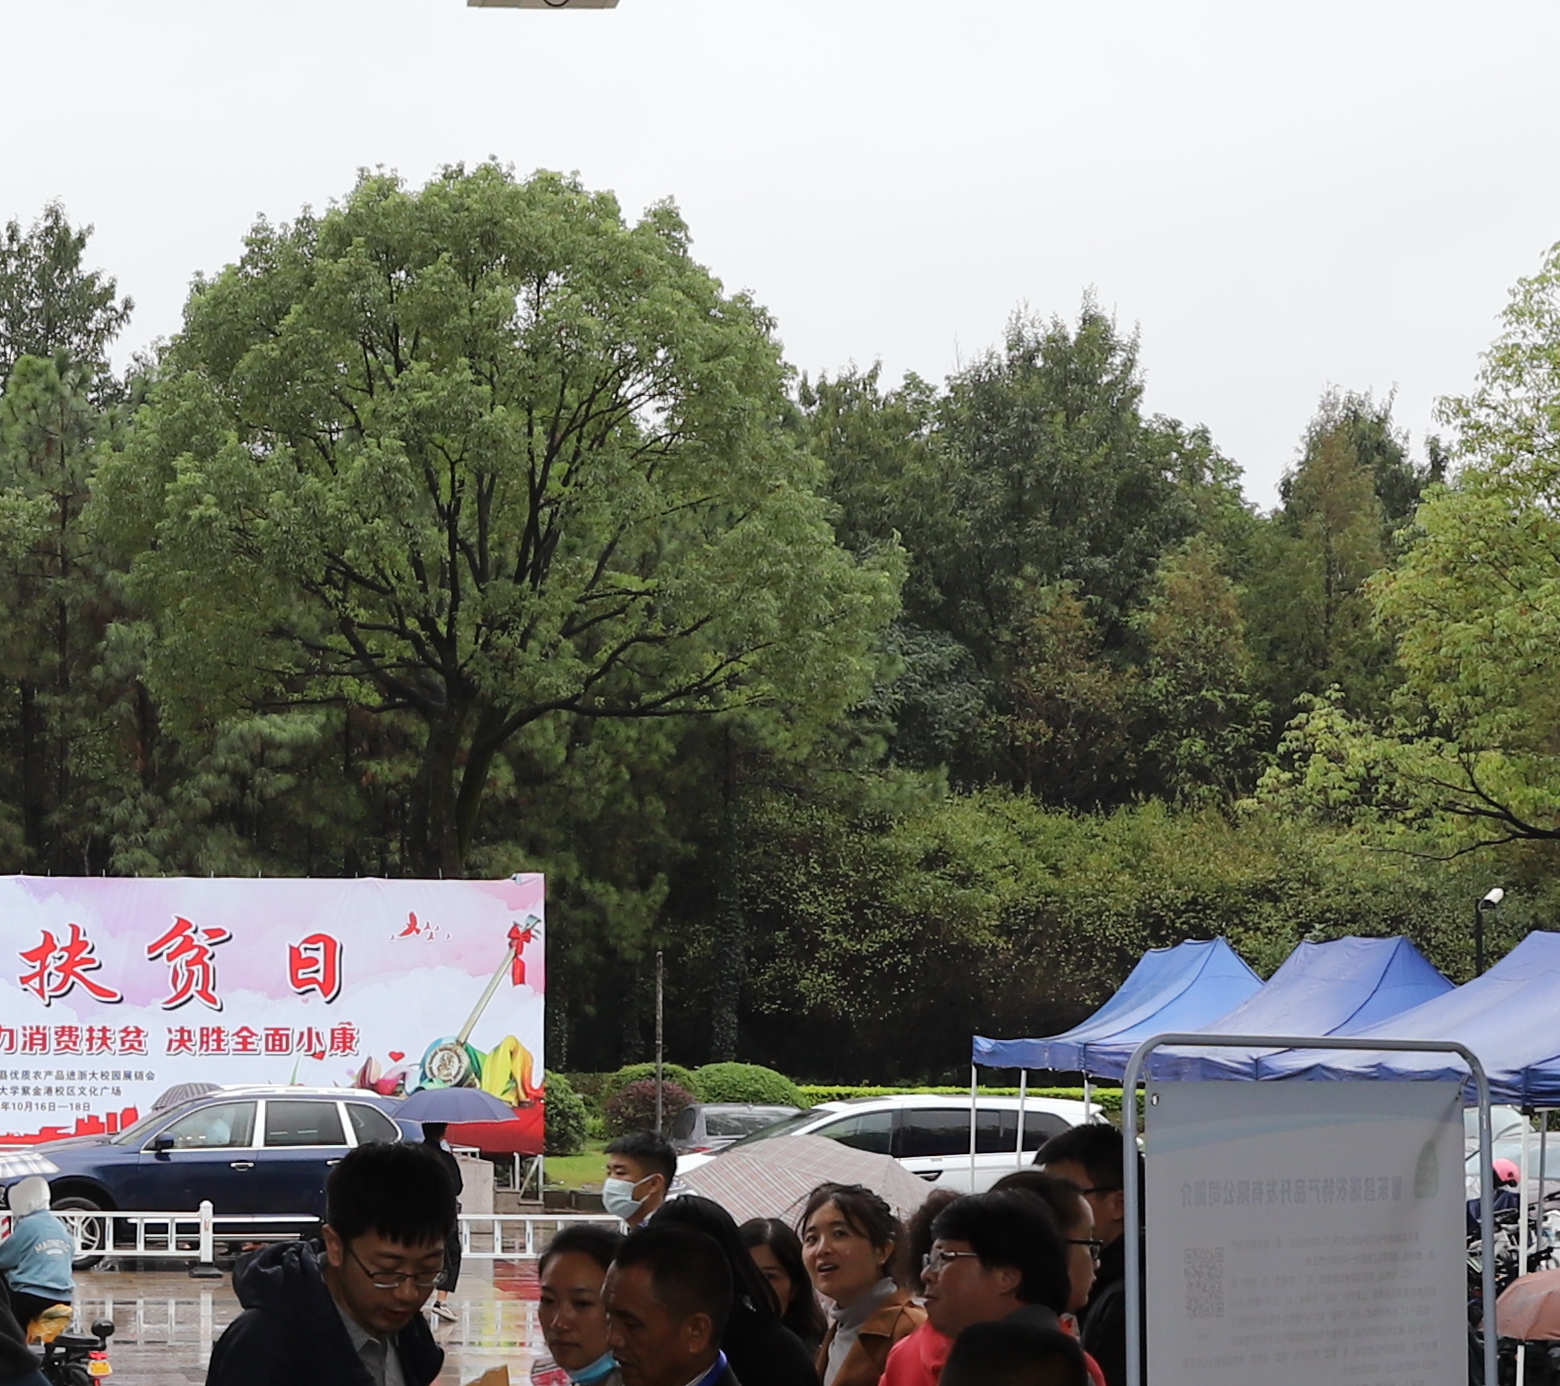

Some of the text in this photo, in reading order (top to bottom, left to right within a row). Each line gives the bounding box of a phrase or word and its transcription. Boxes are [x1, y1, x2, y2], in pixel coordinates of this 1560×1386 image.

[165, 1023, 361, 1055] 决胜全面小康
